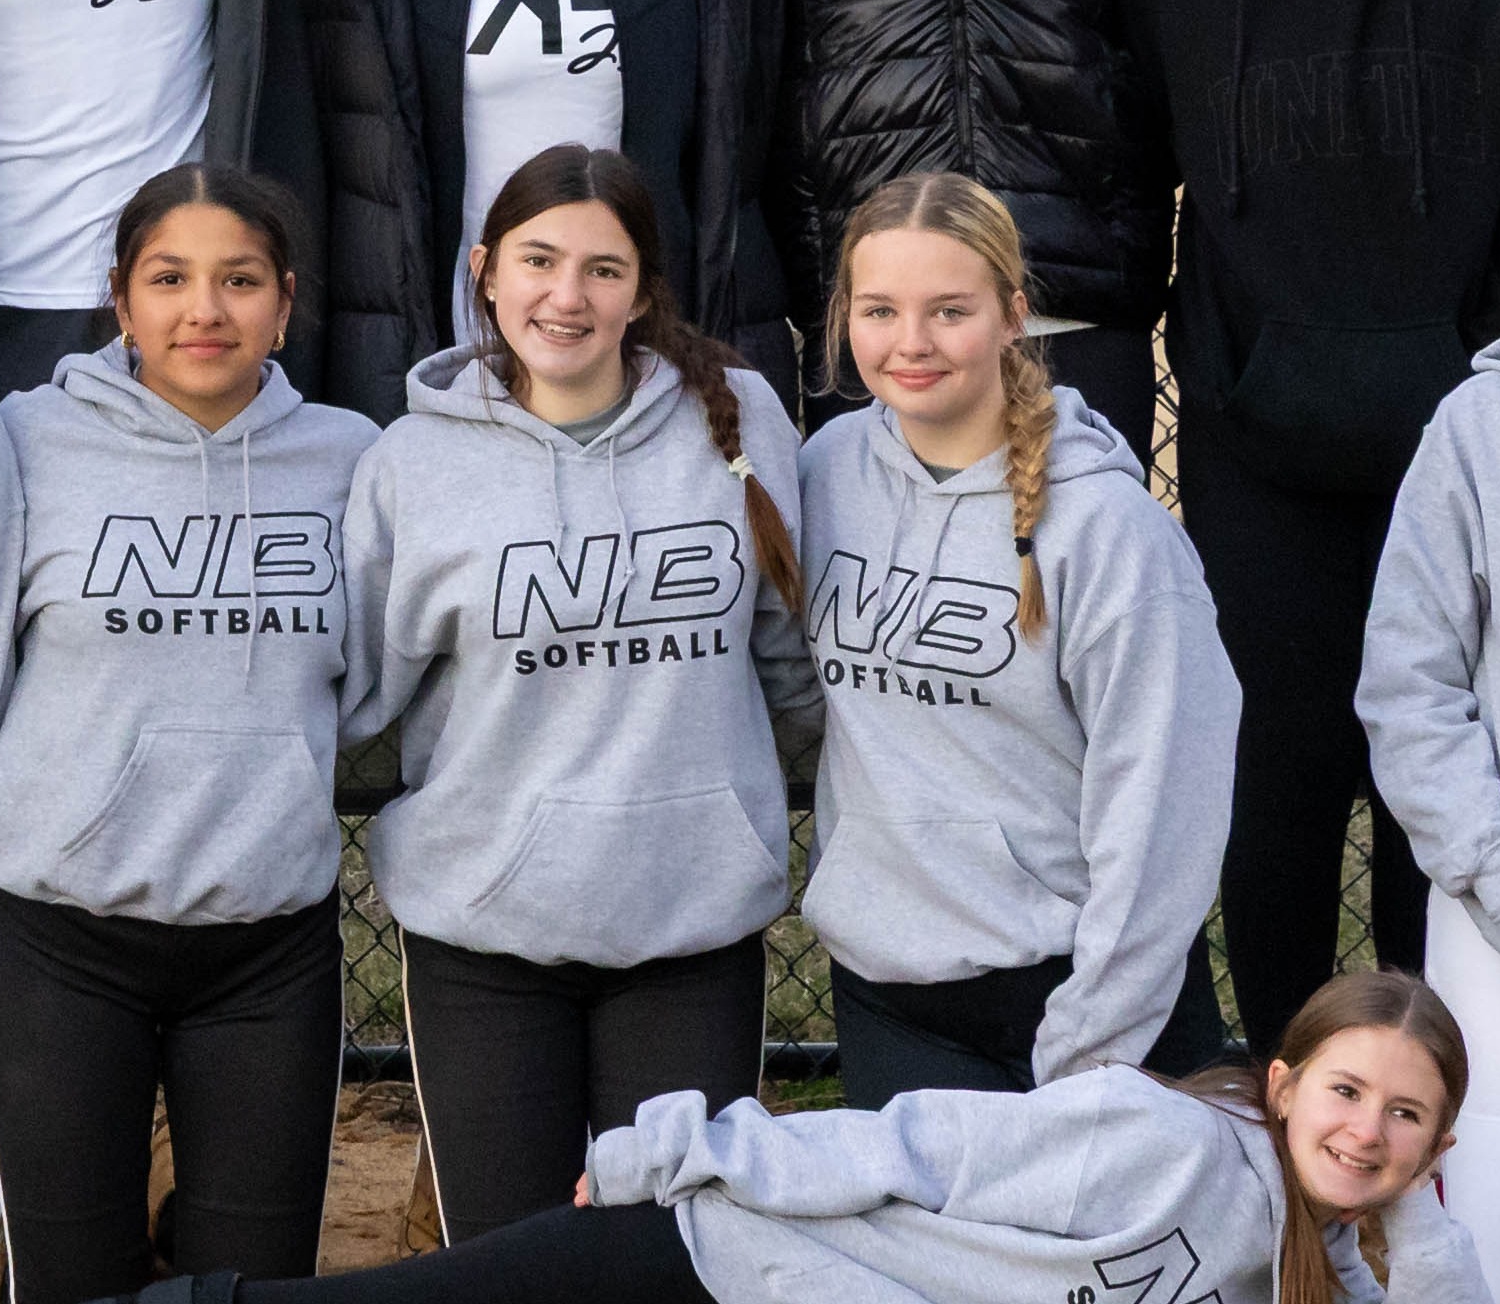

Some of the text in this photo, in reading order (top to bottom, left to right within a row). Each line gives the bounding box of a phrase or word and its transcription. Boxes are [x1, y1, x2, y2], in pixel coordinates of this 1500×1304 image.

[81, 511, 337, 598] NB
[493, 520, 745, 639] NB
[104, 606, 330, 635] SOFTBALL
[514, 629, 729, 675] SOFTBALL
[808, 549, 1021, 678] NB
